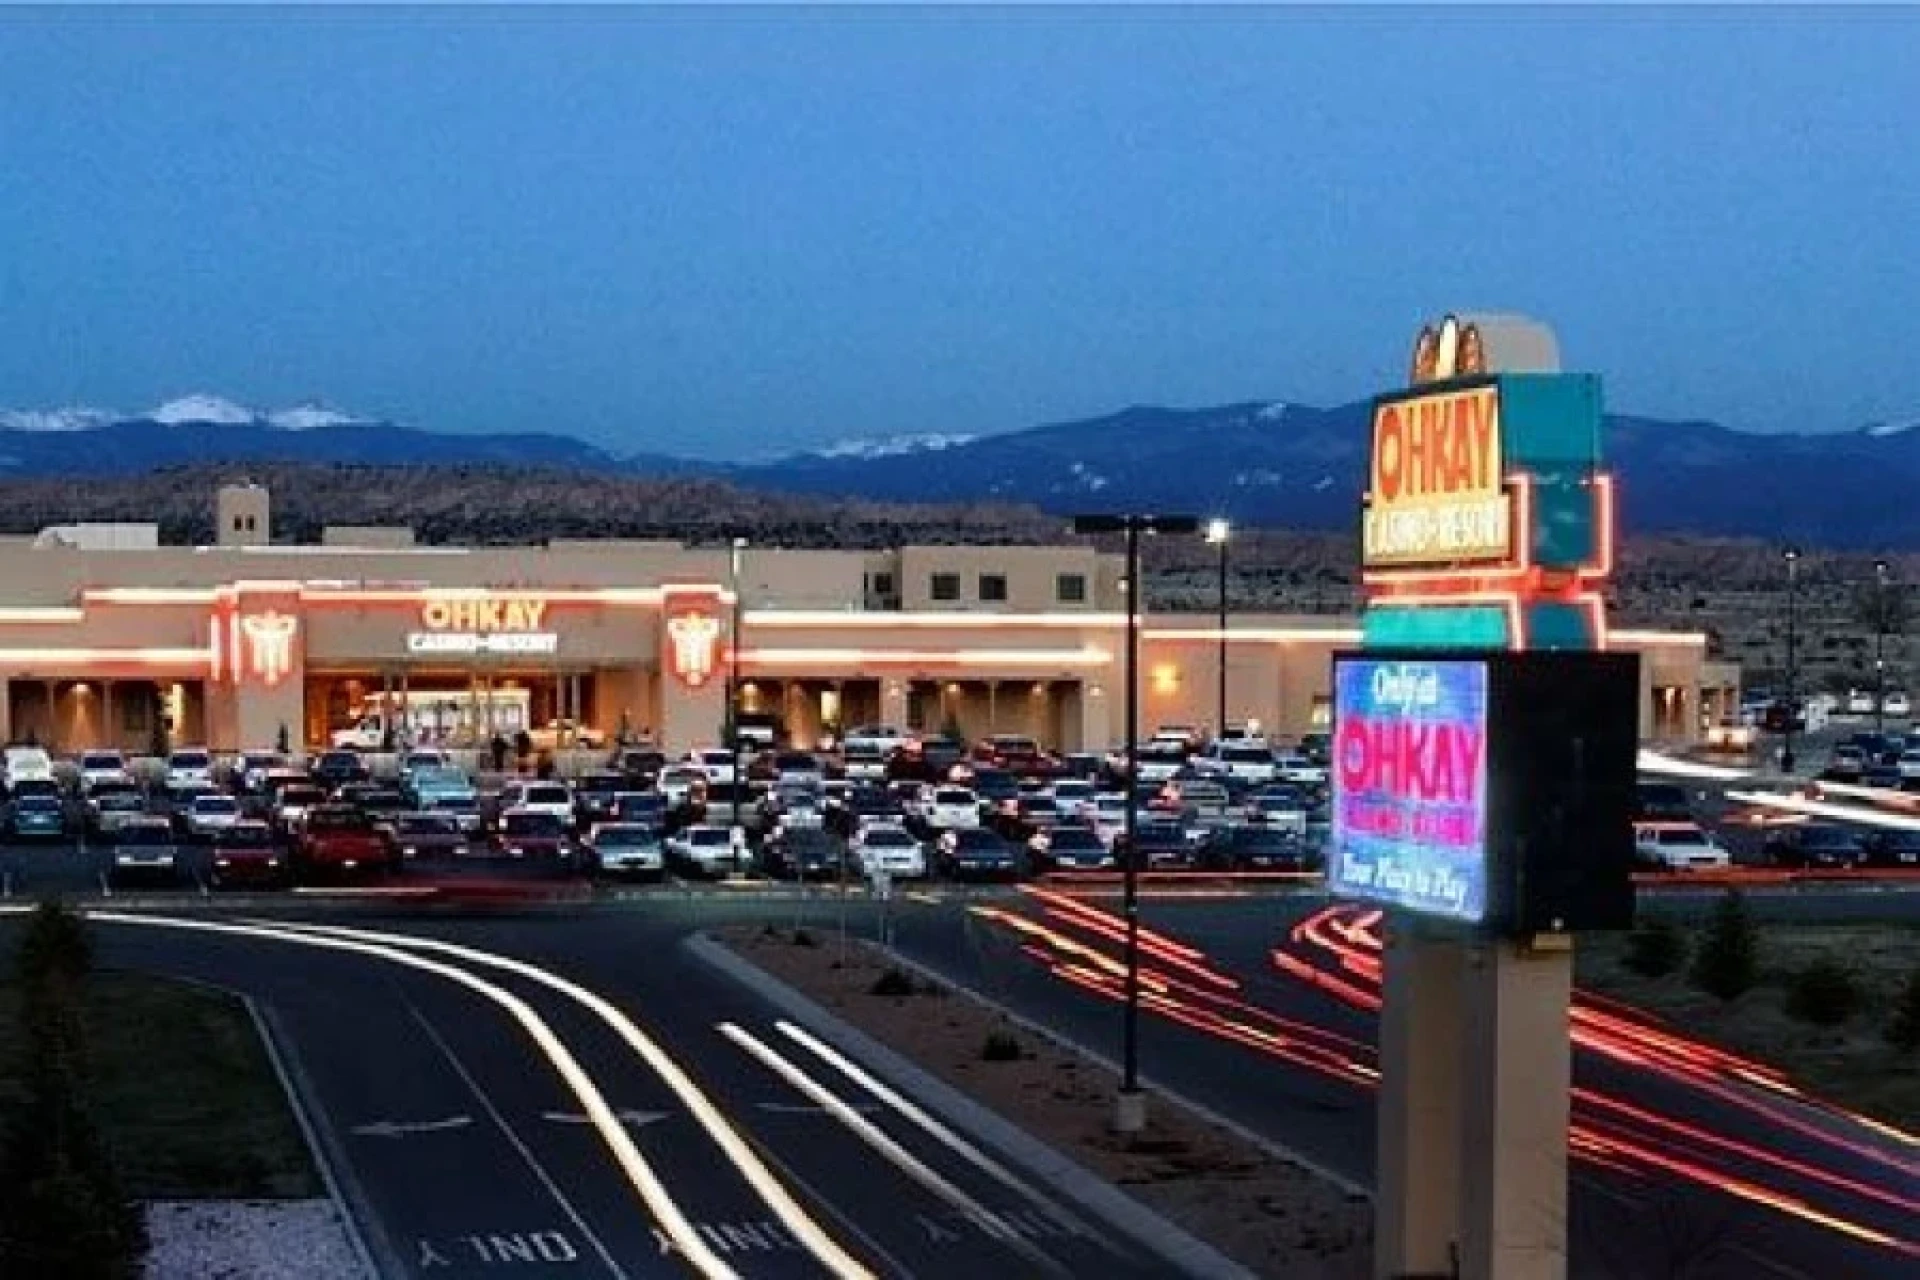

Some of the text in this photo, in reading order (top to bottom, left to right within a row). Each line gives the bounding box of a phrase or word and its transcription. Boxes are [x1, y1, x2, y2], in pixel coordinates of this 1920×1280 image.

[1379, 395, 1495, 503] OHKAY
[424, 598, 546, 631] OHKAY
[1340, 715, 1479, 801] OHKAY
[418, 1232, 577, 1266] ONLY
